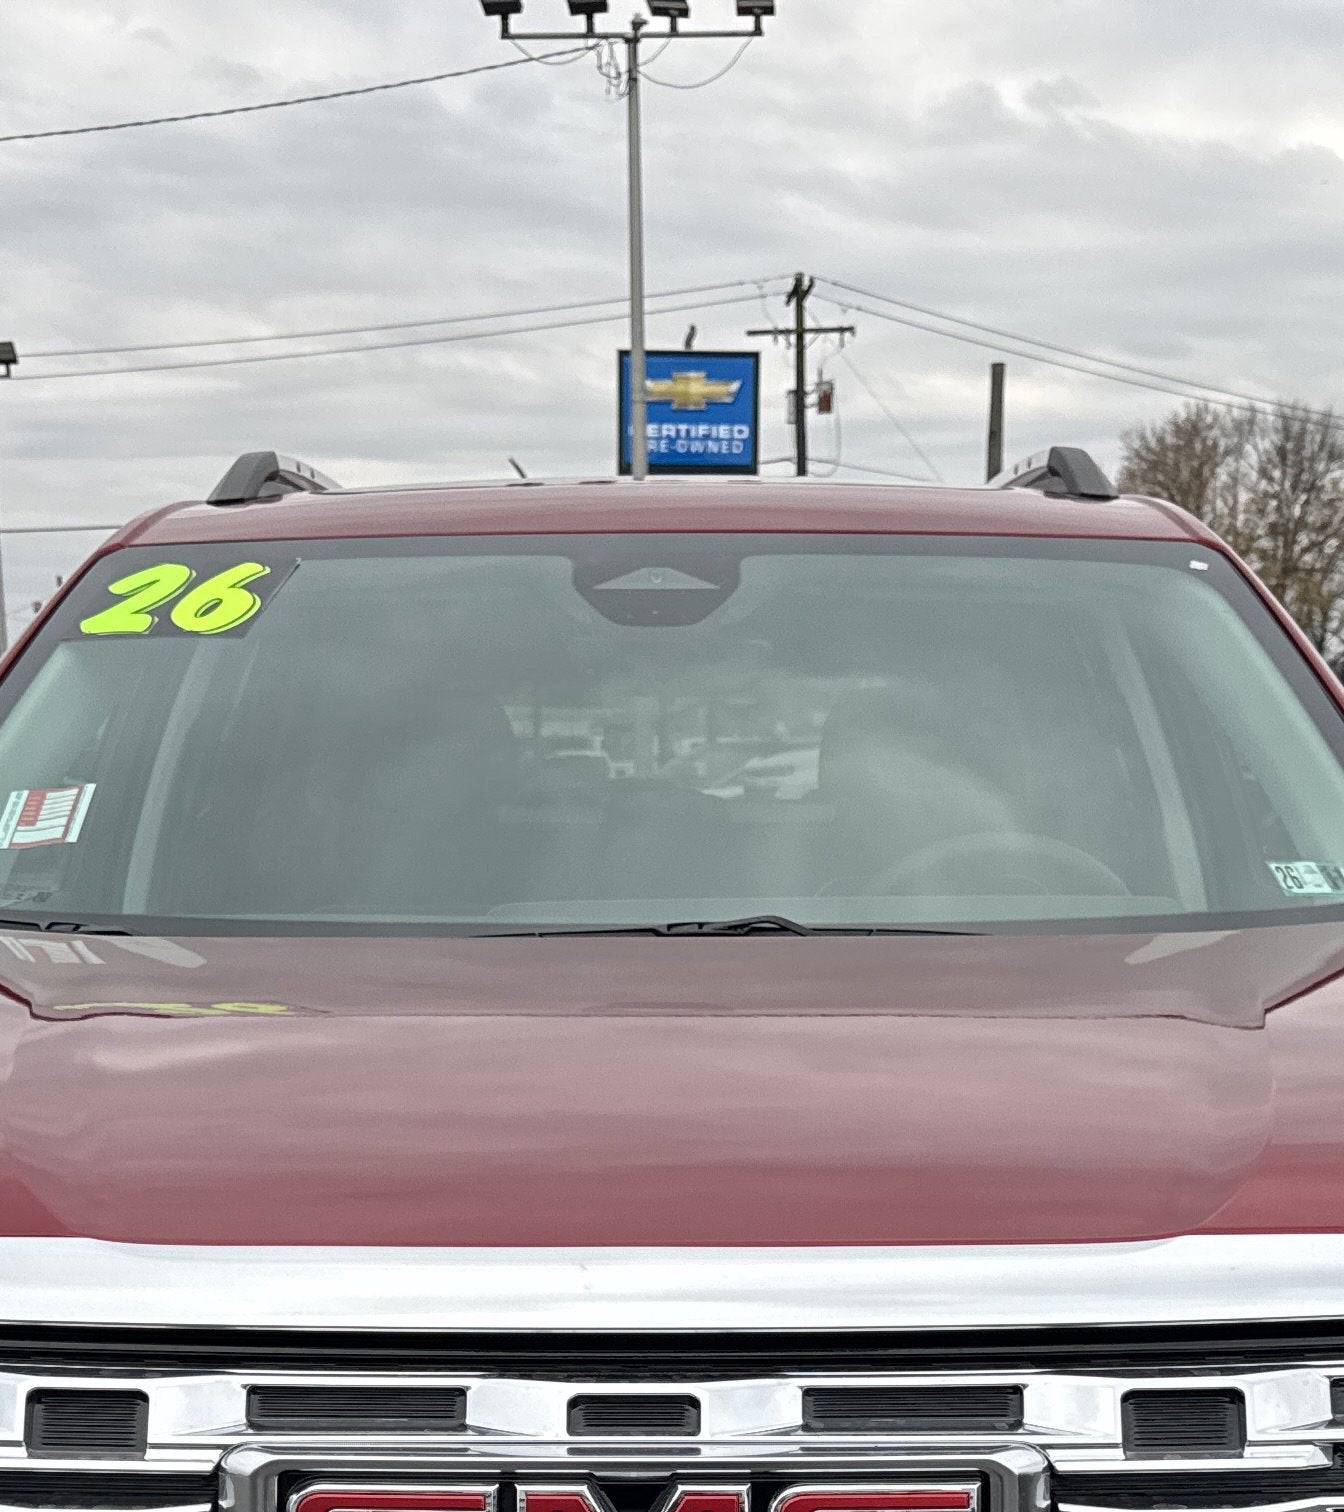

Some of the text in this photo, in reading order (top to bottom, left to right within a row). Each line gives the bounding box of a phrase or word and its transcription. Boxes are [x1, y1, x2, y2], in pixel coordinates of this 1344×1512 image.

[628, 423, 750, 439] ERTIFIED
[79, 562, 271, 635] 26
[1274, 865, 1304, 890] 26
